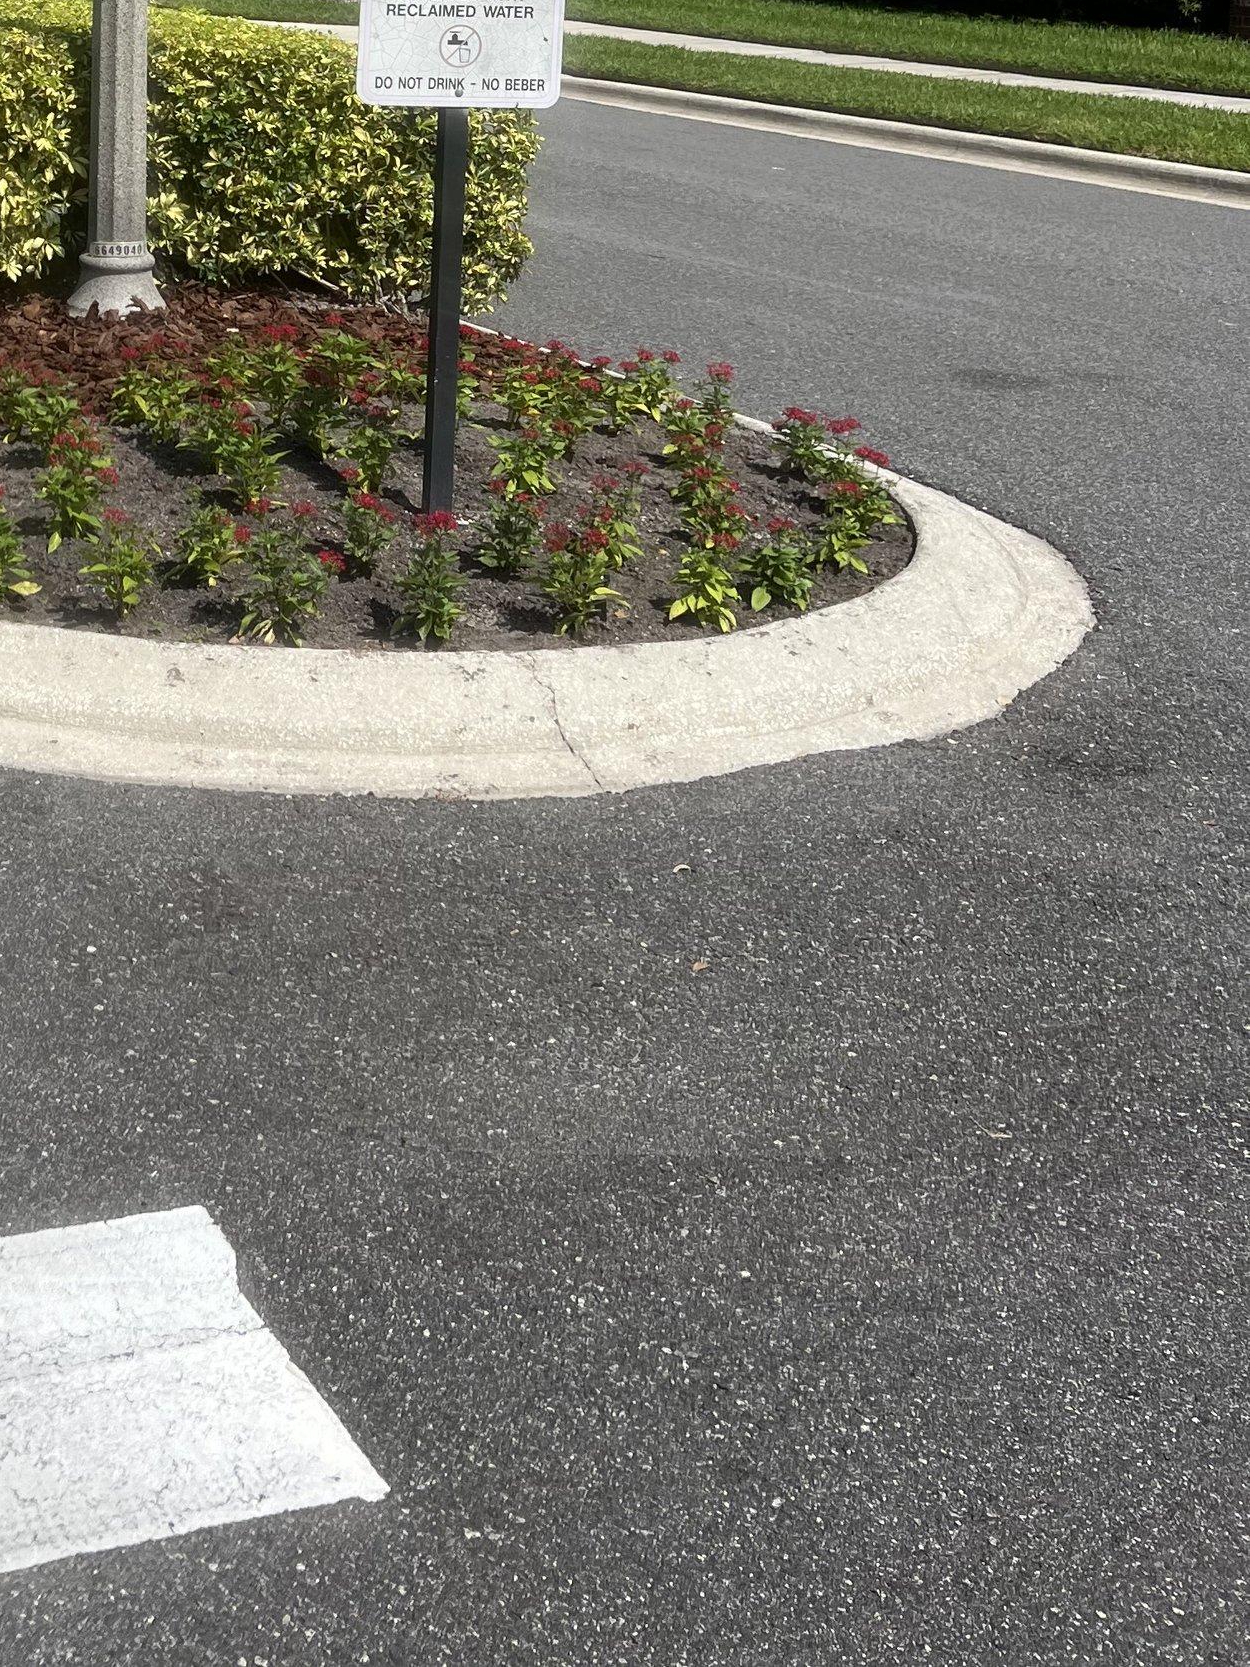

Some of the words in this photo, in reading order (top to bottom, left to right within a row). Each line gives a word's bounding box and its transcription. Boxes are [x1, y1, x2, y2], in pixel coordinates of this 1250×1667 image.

[386, 4, 476, 18] RECLAIMED
[483, 5, 534, 19] WATER
[374, 76, 393, 90] DO
[398, 76, 423, 90] NOT
[428, 77, 465, 90] DRINK
[481, 78, 500, 91] NO
[504, 78, 545, 91] BEBER
